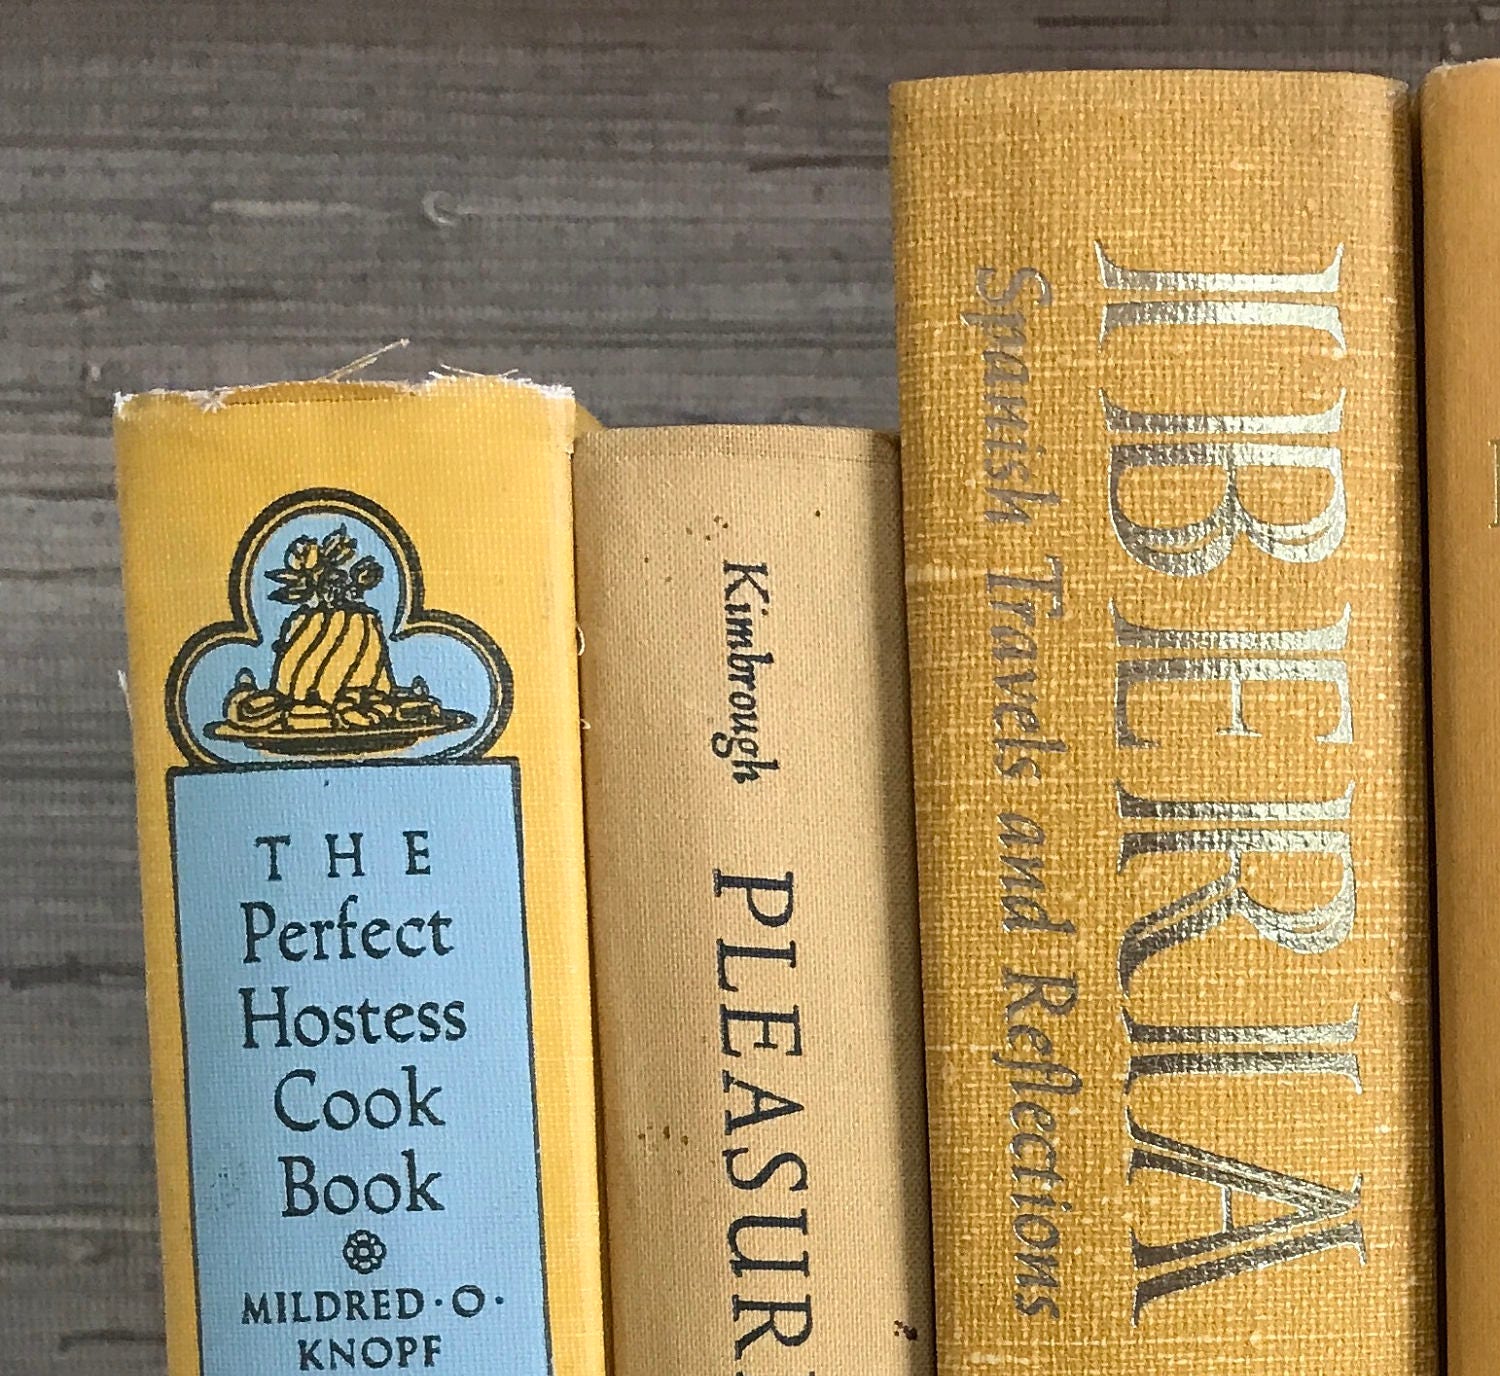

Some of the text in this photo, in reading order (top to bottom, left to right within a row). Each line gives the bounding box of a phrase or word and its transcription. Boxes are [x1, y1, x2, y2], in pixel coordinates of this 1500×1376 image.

[709, 558, 782, 786] Kimbrough
[960, 265, 1084, 1322] Spanish Travels and Reflections
[1093, 240, 1369, 1328] IBERIA
[255, 832, 434, 882] THE
[239, 895, 455, 965] Perfect
[238, 986, 468, 1050] Hostess
[273, 1065, 447, 1133] Cook
[280, 1149, 446, 1218] Book
[297, 1334, 442, 1371] KNOPF
